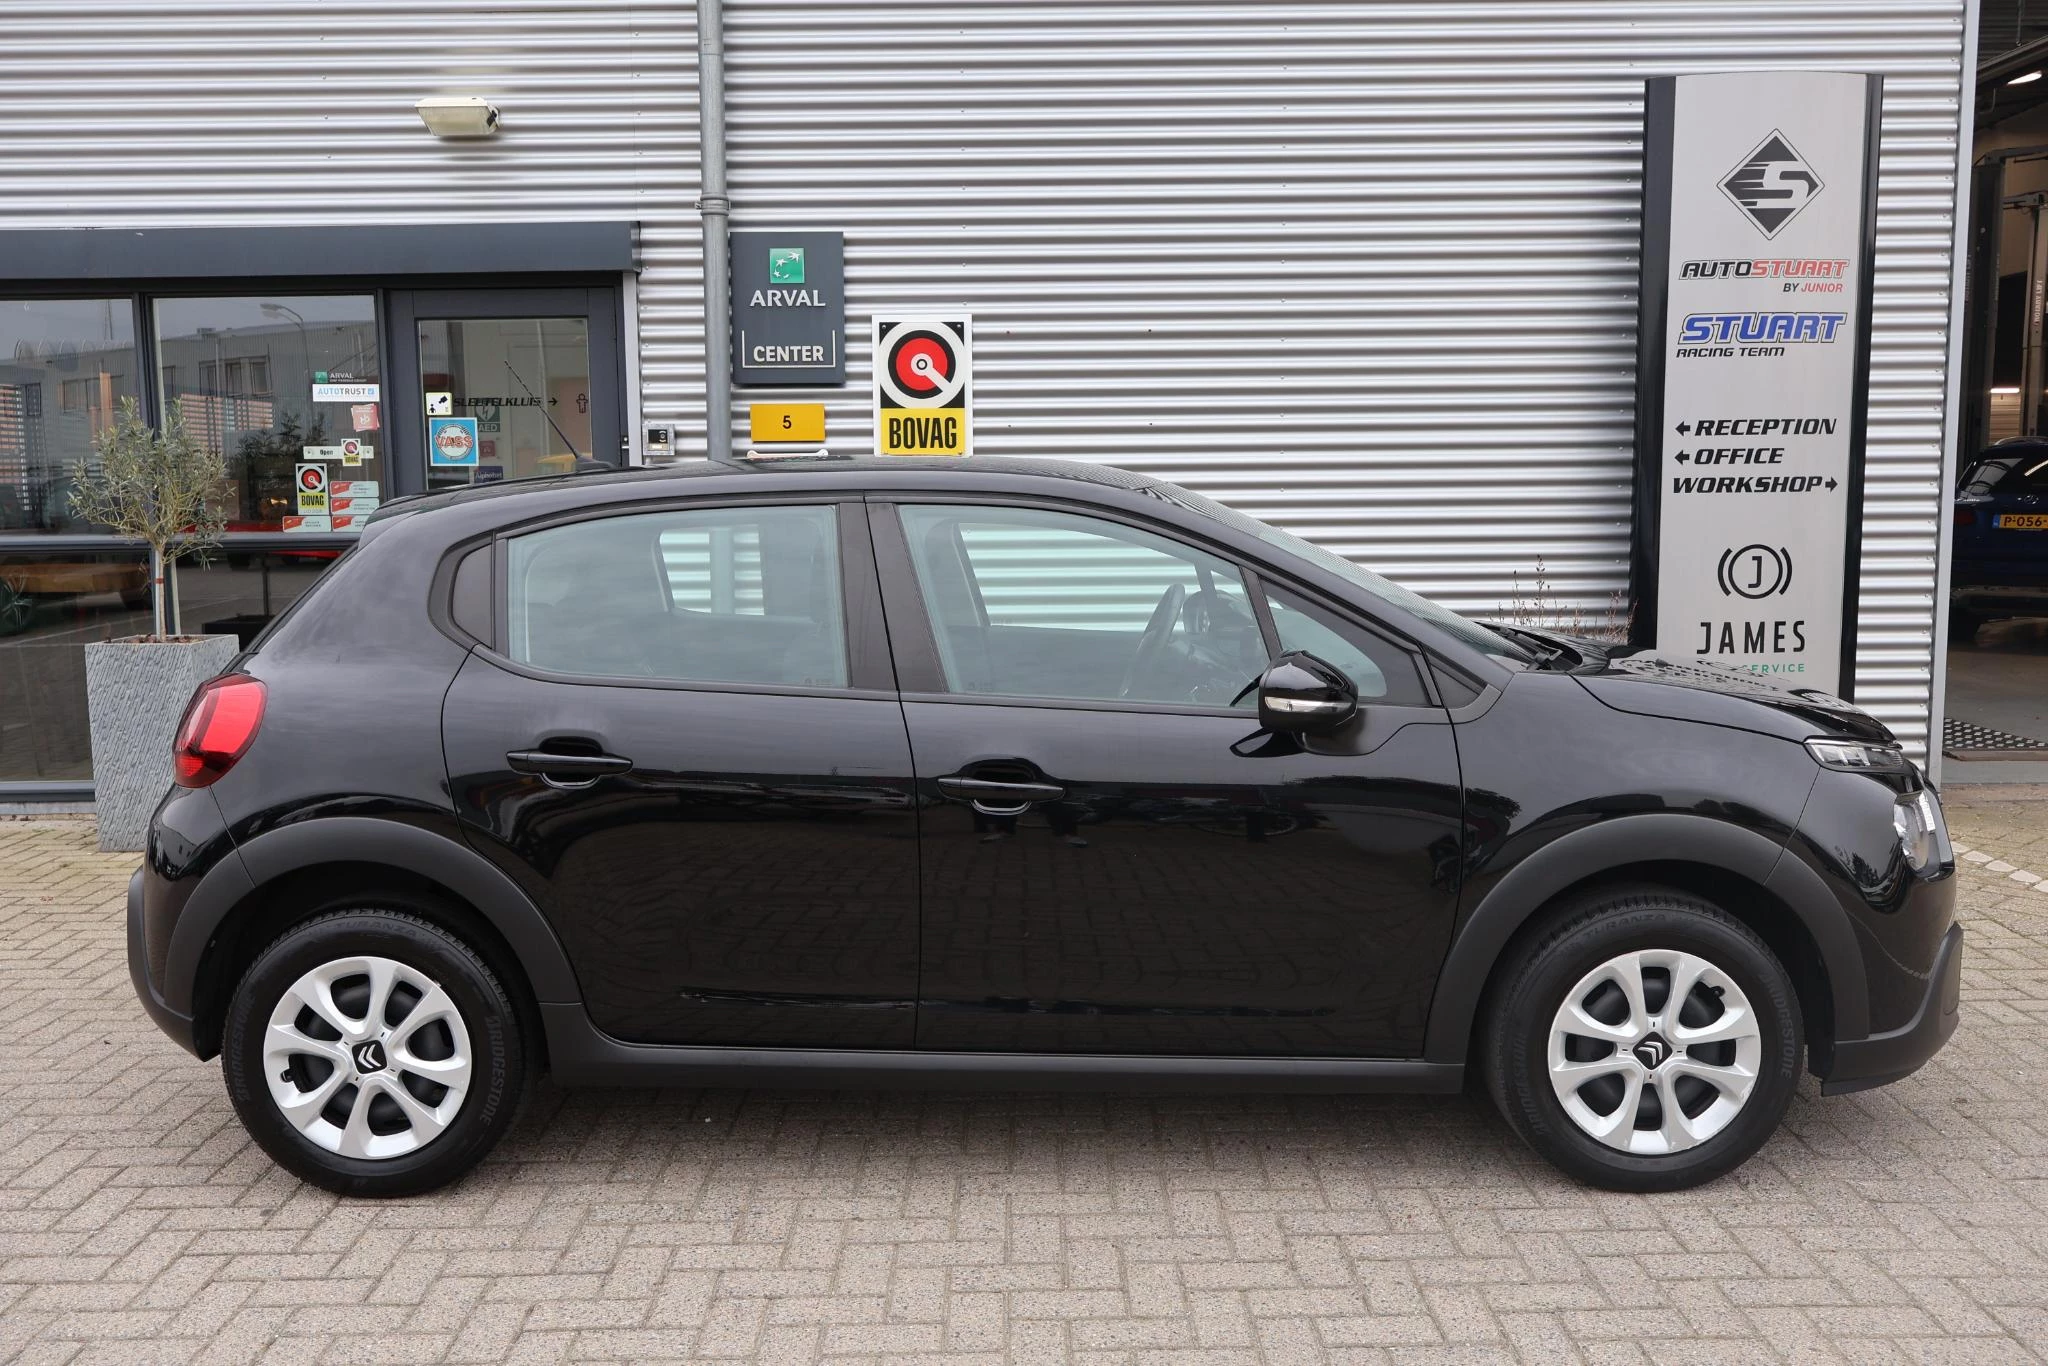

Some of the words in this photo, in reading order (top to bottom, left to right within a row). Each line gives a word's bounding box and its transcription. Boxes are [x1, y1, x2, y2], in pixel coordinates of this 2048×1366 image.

[1680, 259, 1849, 280] AUTOSTUART
[1783, 283, 1800, 293] BY
[1801, 283, 1843, 293] JUNIOR
[750, 289, 826, 307] ARVAL
[1678, 312, 1848, 345] STUART
[753, 345, 824, 362] CENTER
[1676, 348, 1734, 358] RACING
[1740, 347, 1785, 357] TEAM
[318, 387, 366, 395] AUTOTRUST
[479, 424, 498, 432] AED
[782, 415, 792, 429] 5
[1695, 418, 1837, 436] RECEPTION
[889, 416, 957, 449] BOVAG
[1694, 448, 1785, 465] OFFICE
[1673, 476, 1823, 493] WORKSHOP
[301, 494, 325, 506] BOVAG
[1696, 620, 1806, 655] JAMES
[480, 1015, 506, 1126] BRIDGESTONE
